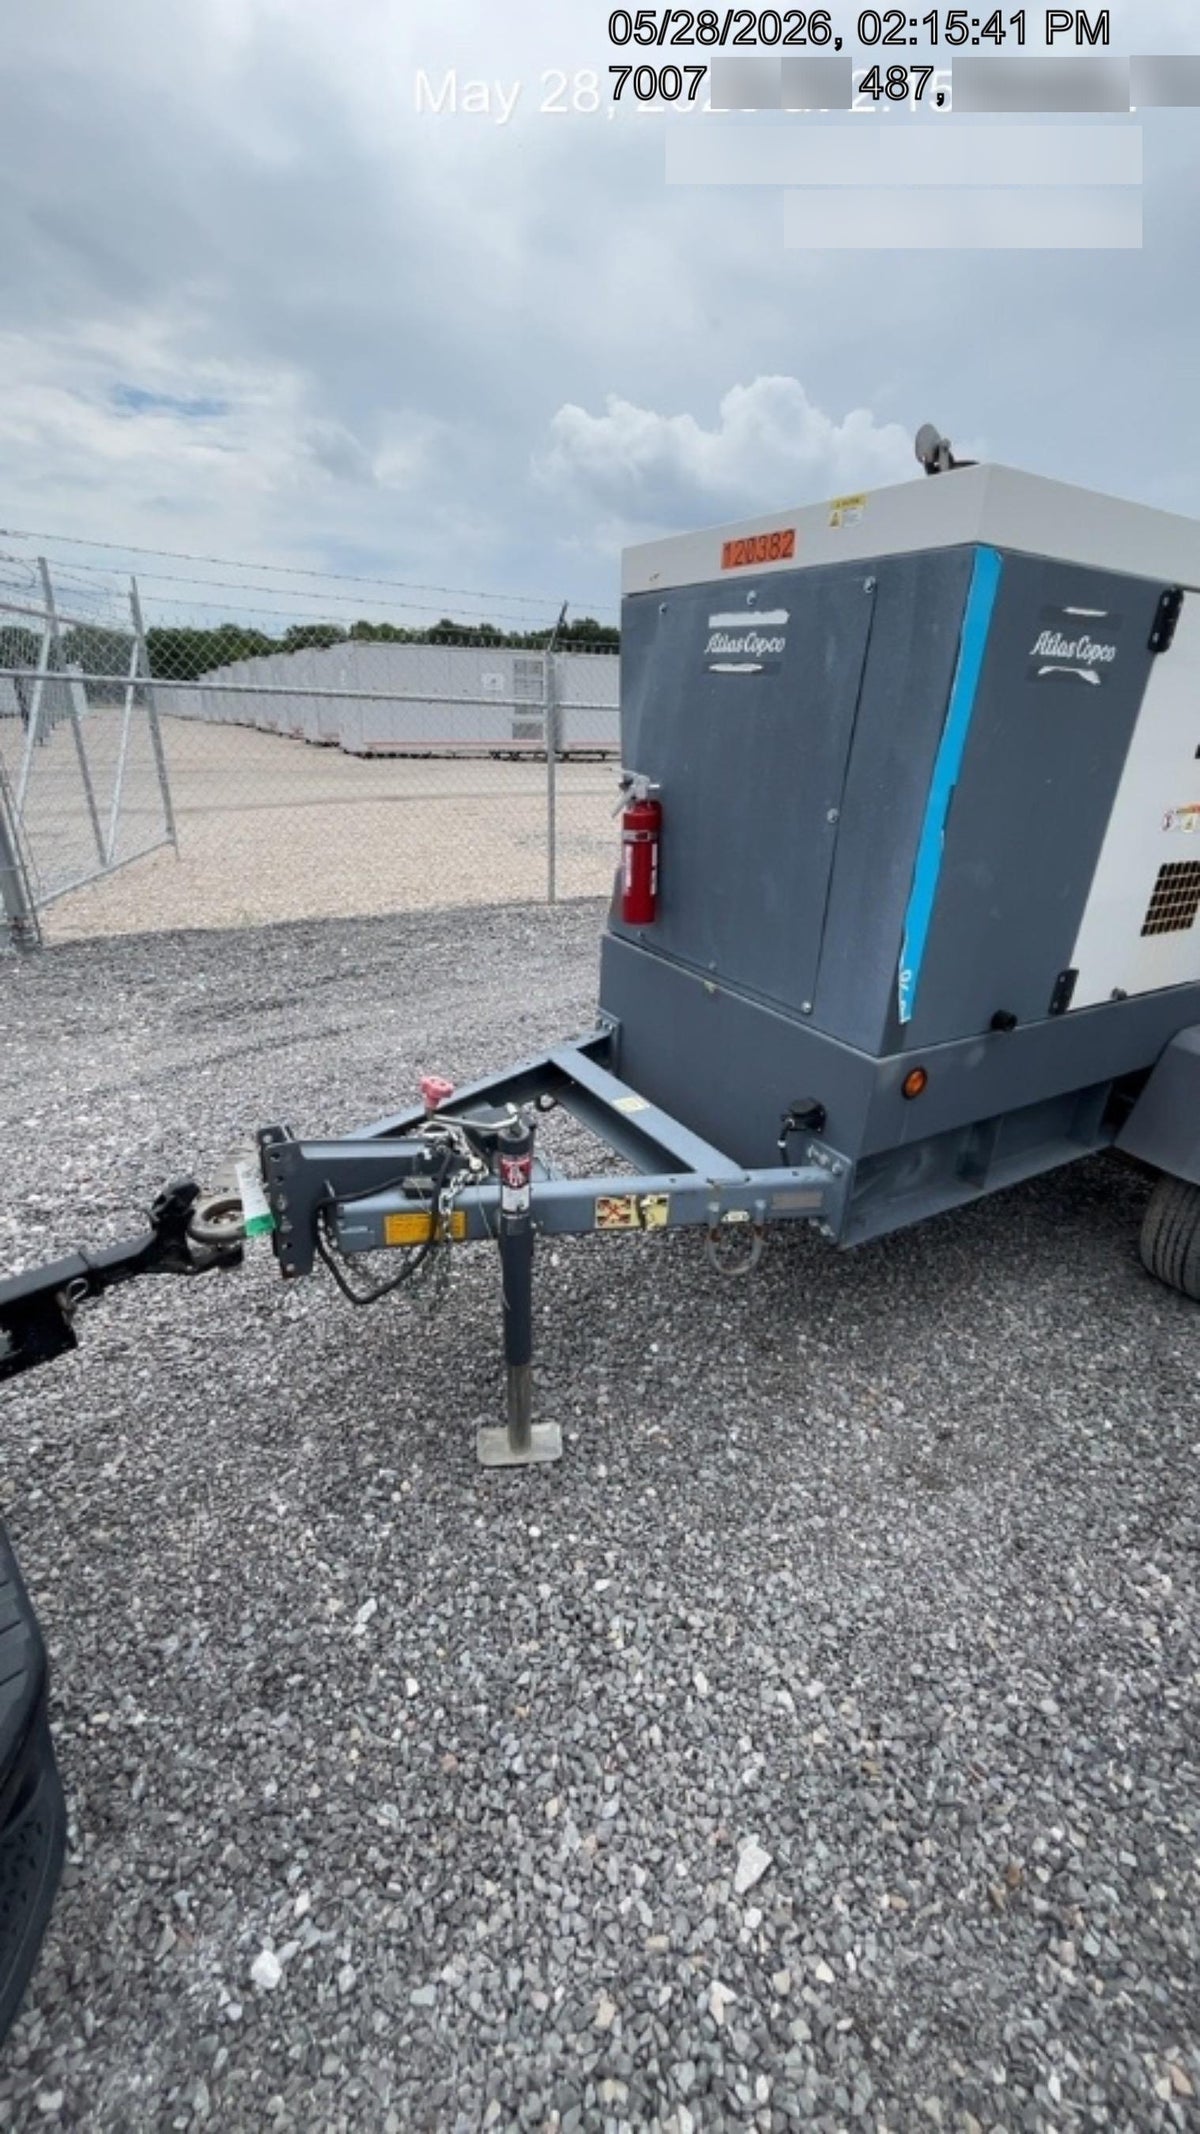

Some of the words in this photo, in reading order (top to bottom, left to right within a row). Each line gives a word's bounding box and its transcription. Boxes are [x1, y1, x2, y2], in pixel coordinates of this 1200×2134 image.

[704, 632, 745, 653] Atlas
[744, 632, 786, 657] Copco
[1029, 630, 1076, 658] Atlas
[1075, 635, 1117, 665] Copco
